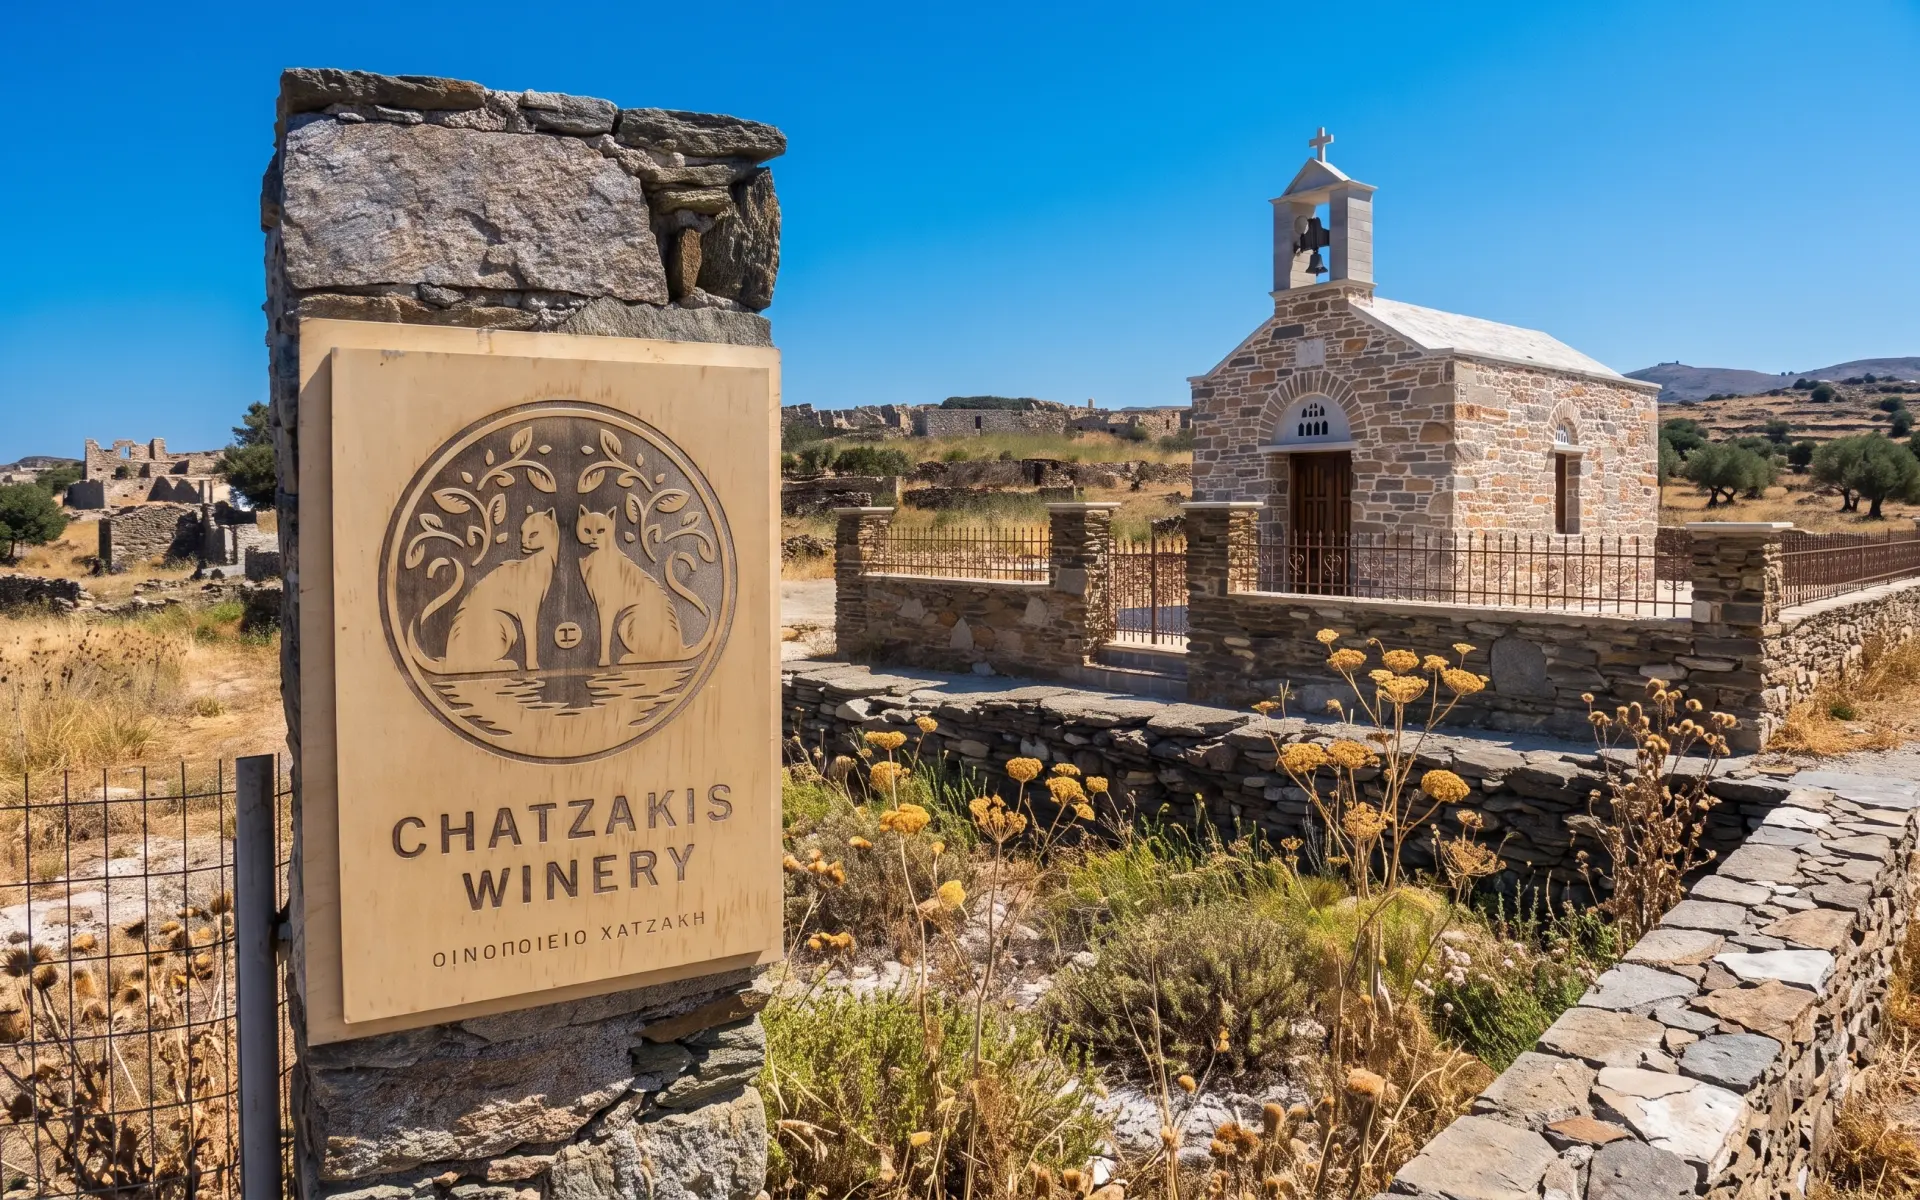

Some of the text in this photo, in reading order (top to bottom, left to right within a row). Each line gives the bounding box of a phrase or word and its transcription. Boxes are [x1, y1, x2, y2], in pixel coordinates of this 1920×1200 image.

[391, 783, 734, 859] CHATZAKIS
[462, 843, 696, 912] WINERY
[432, 910, 706, 968] ΟΙΝΟΠΟΙΕΙΟ ΧΑΤΖΑΚΗ
